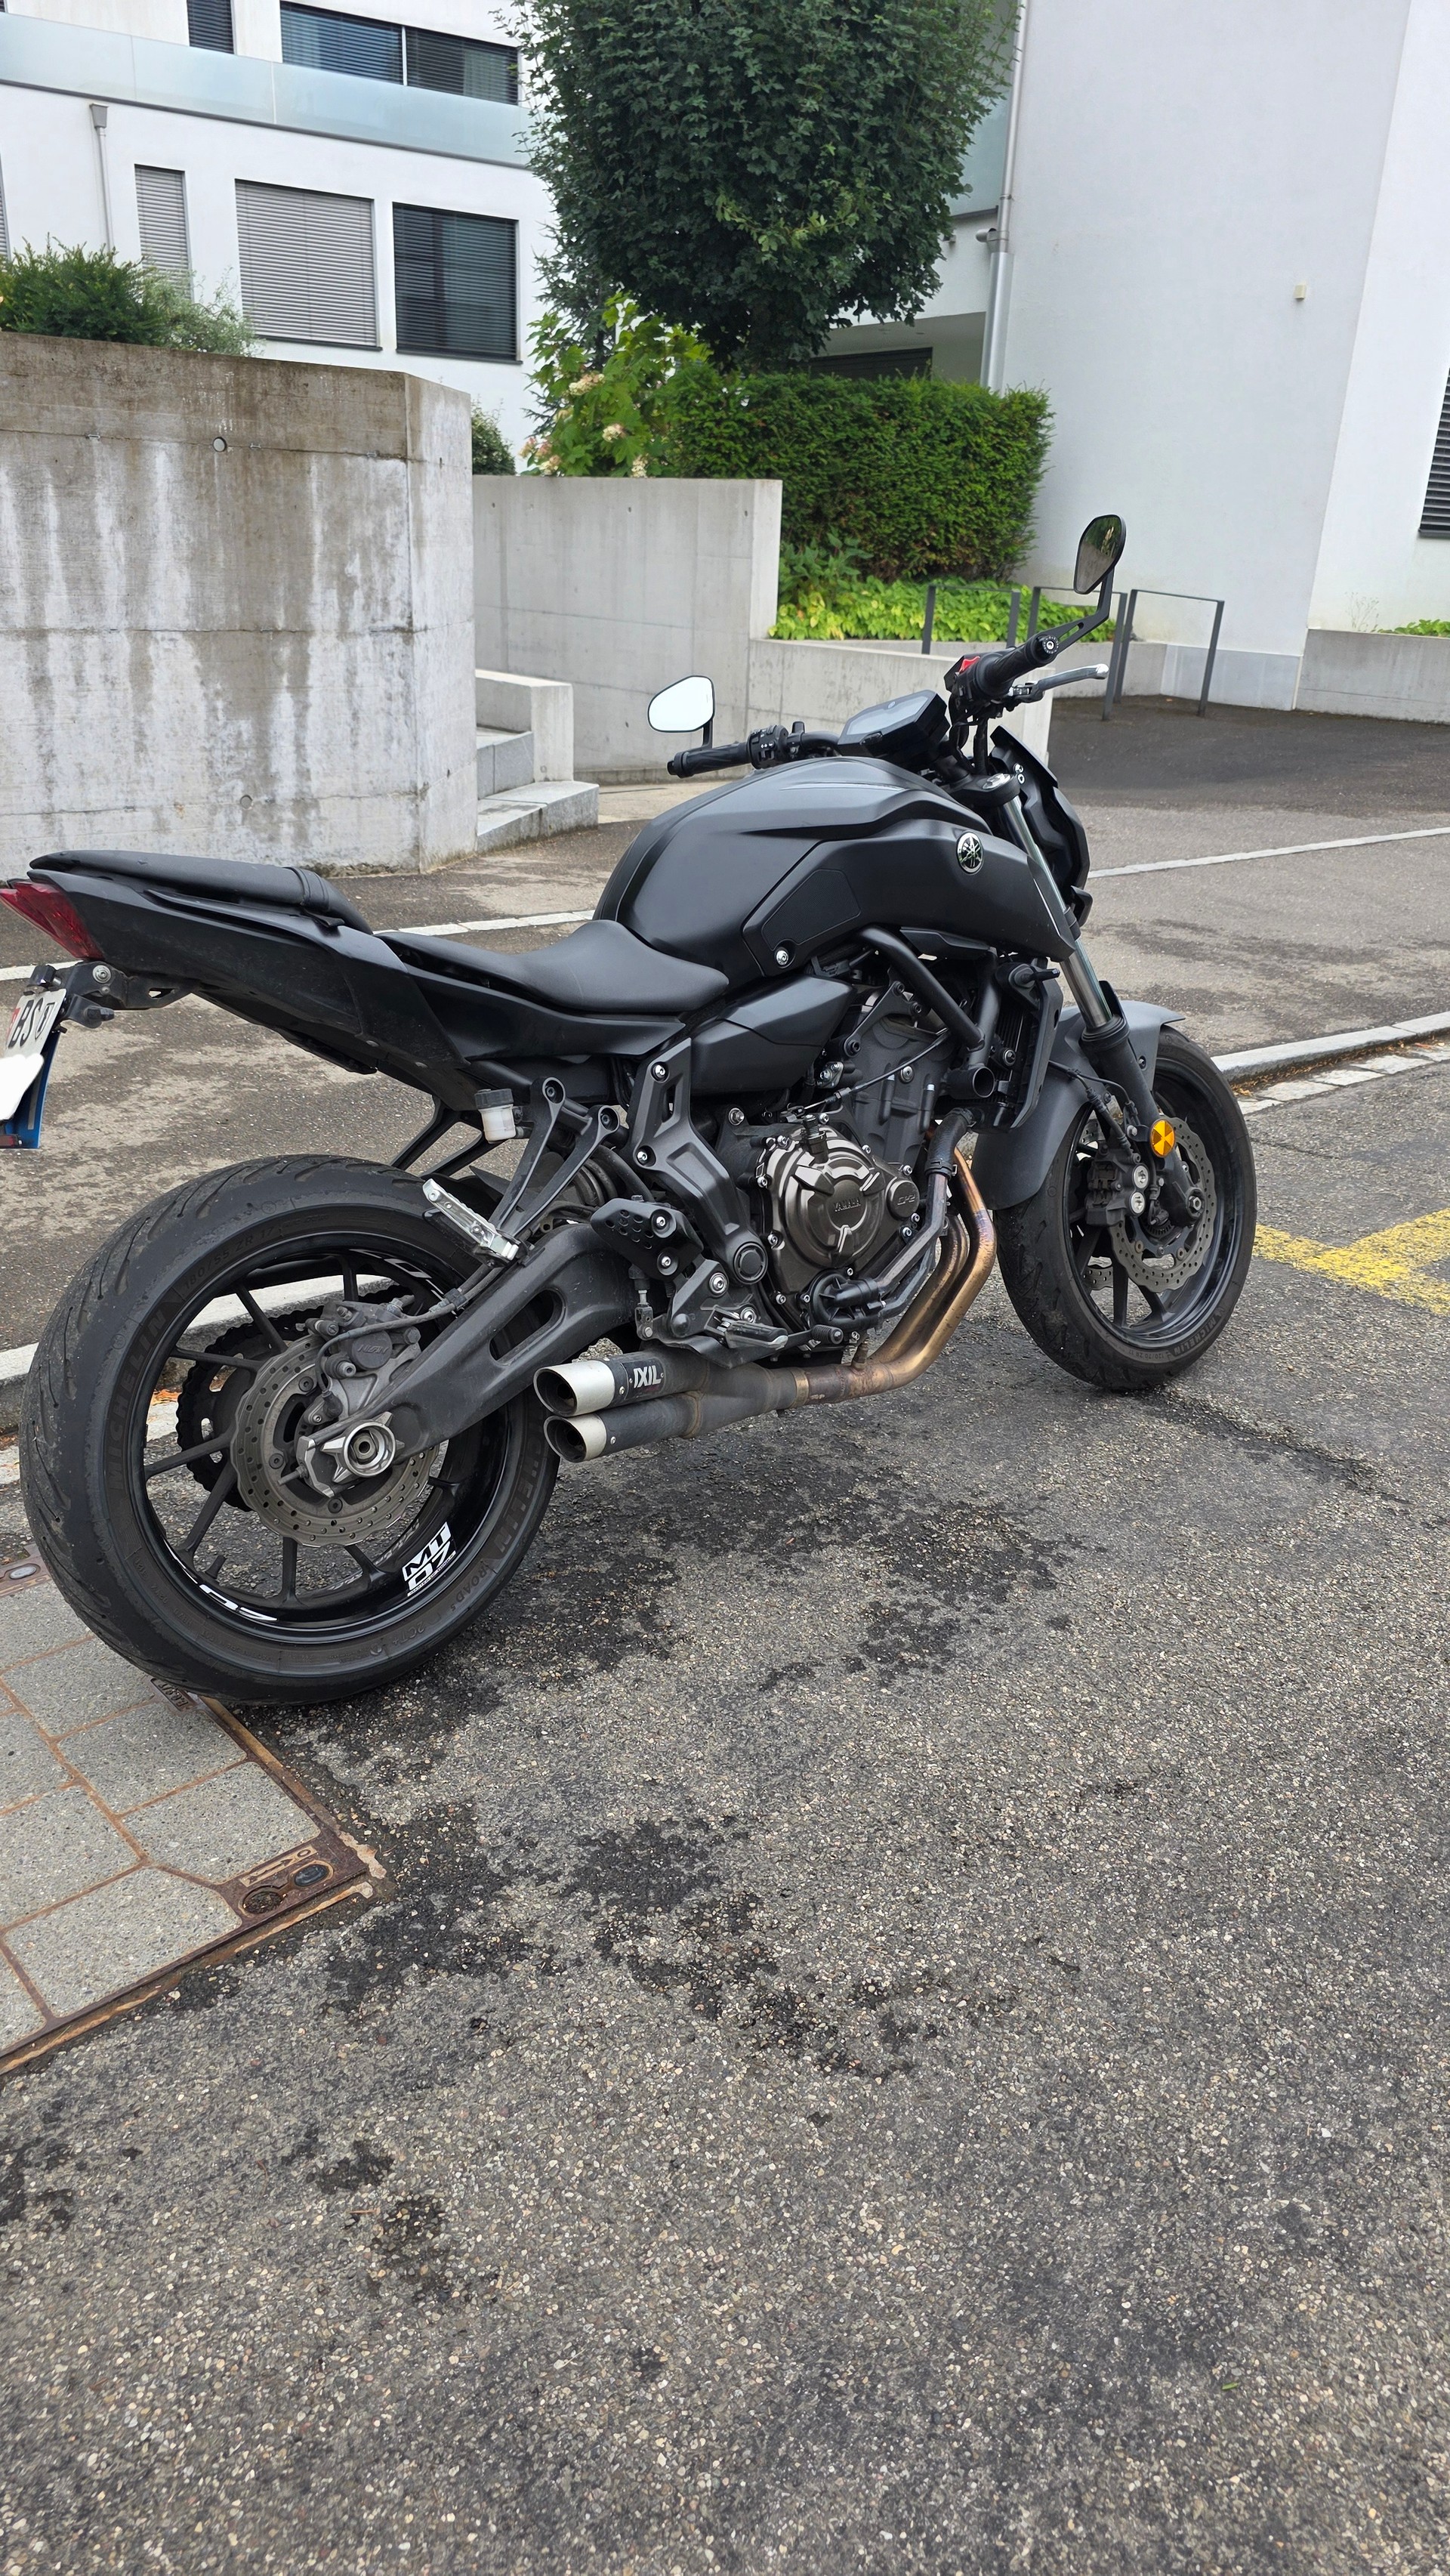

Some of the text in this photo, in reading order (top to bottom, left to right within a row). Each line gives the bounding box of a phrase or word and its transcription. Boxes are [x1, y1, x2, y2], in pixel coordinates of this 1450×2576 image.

[8, 997, 44, 1049] BS
[234, 1237, 254, 1252] ZR
[1173, 1316, 1217, 1355] MICHELIN
[633, 1364, 662, 1388] IXIL
[106, 1308, 167, 1491] MICHELIN
[402, 1521, 452, 1581] MT
[408, 1540, 451, 1590] 07
[455, 1568, 489, 1603] ROAD
